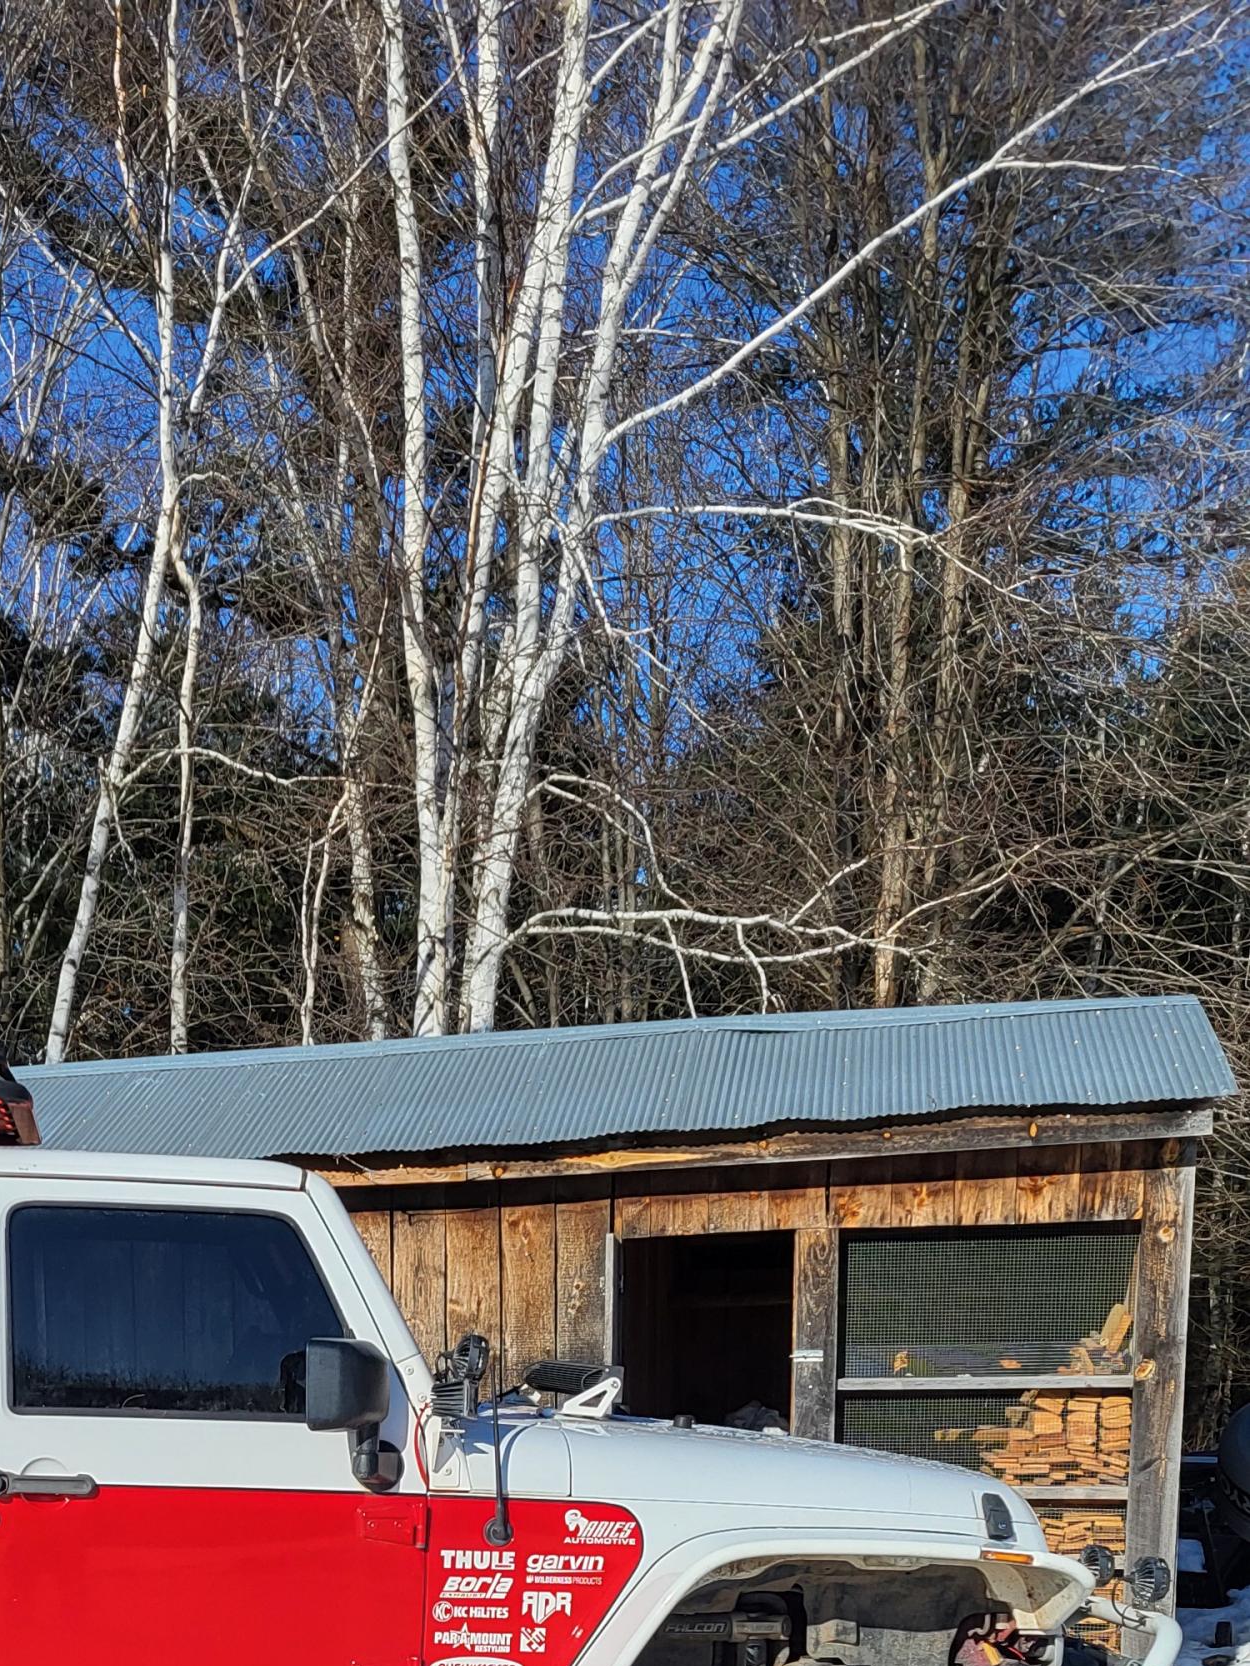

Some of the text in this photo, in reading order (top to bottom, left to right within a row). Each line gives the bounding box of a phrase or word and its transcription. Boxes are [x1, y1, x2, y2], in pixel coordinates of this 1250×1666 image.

[564, 1537, 636, 1546] AUTOMOTIVE
[440, 1549, 516, 1571] THULE
[526, 1554, 605, 1573] garvin
[534, 1575, 603, 1586] WILDERNESS PRODUCTS
[434, 1603, 452, 1620] KC
[453, 1606, 469, 1618] KC
[664, 1622, 727, 1634] FALCON
[433, 1630, 513, 1646] PARAMOUNT
